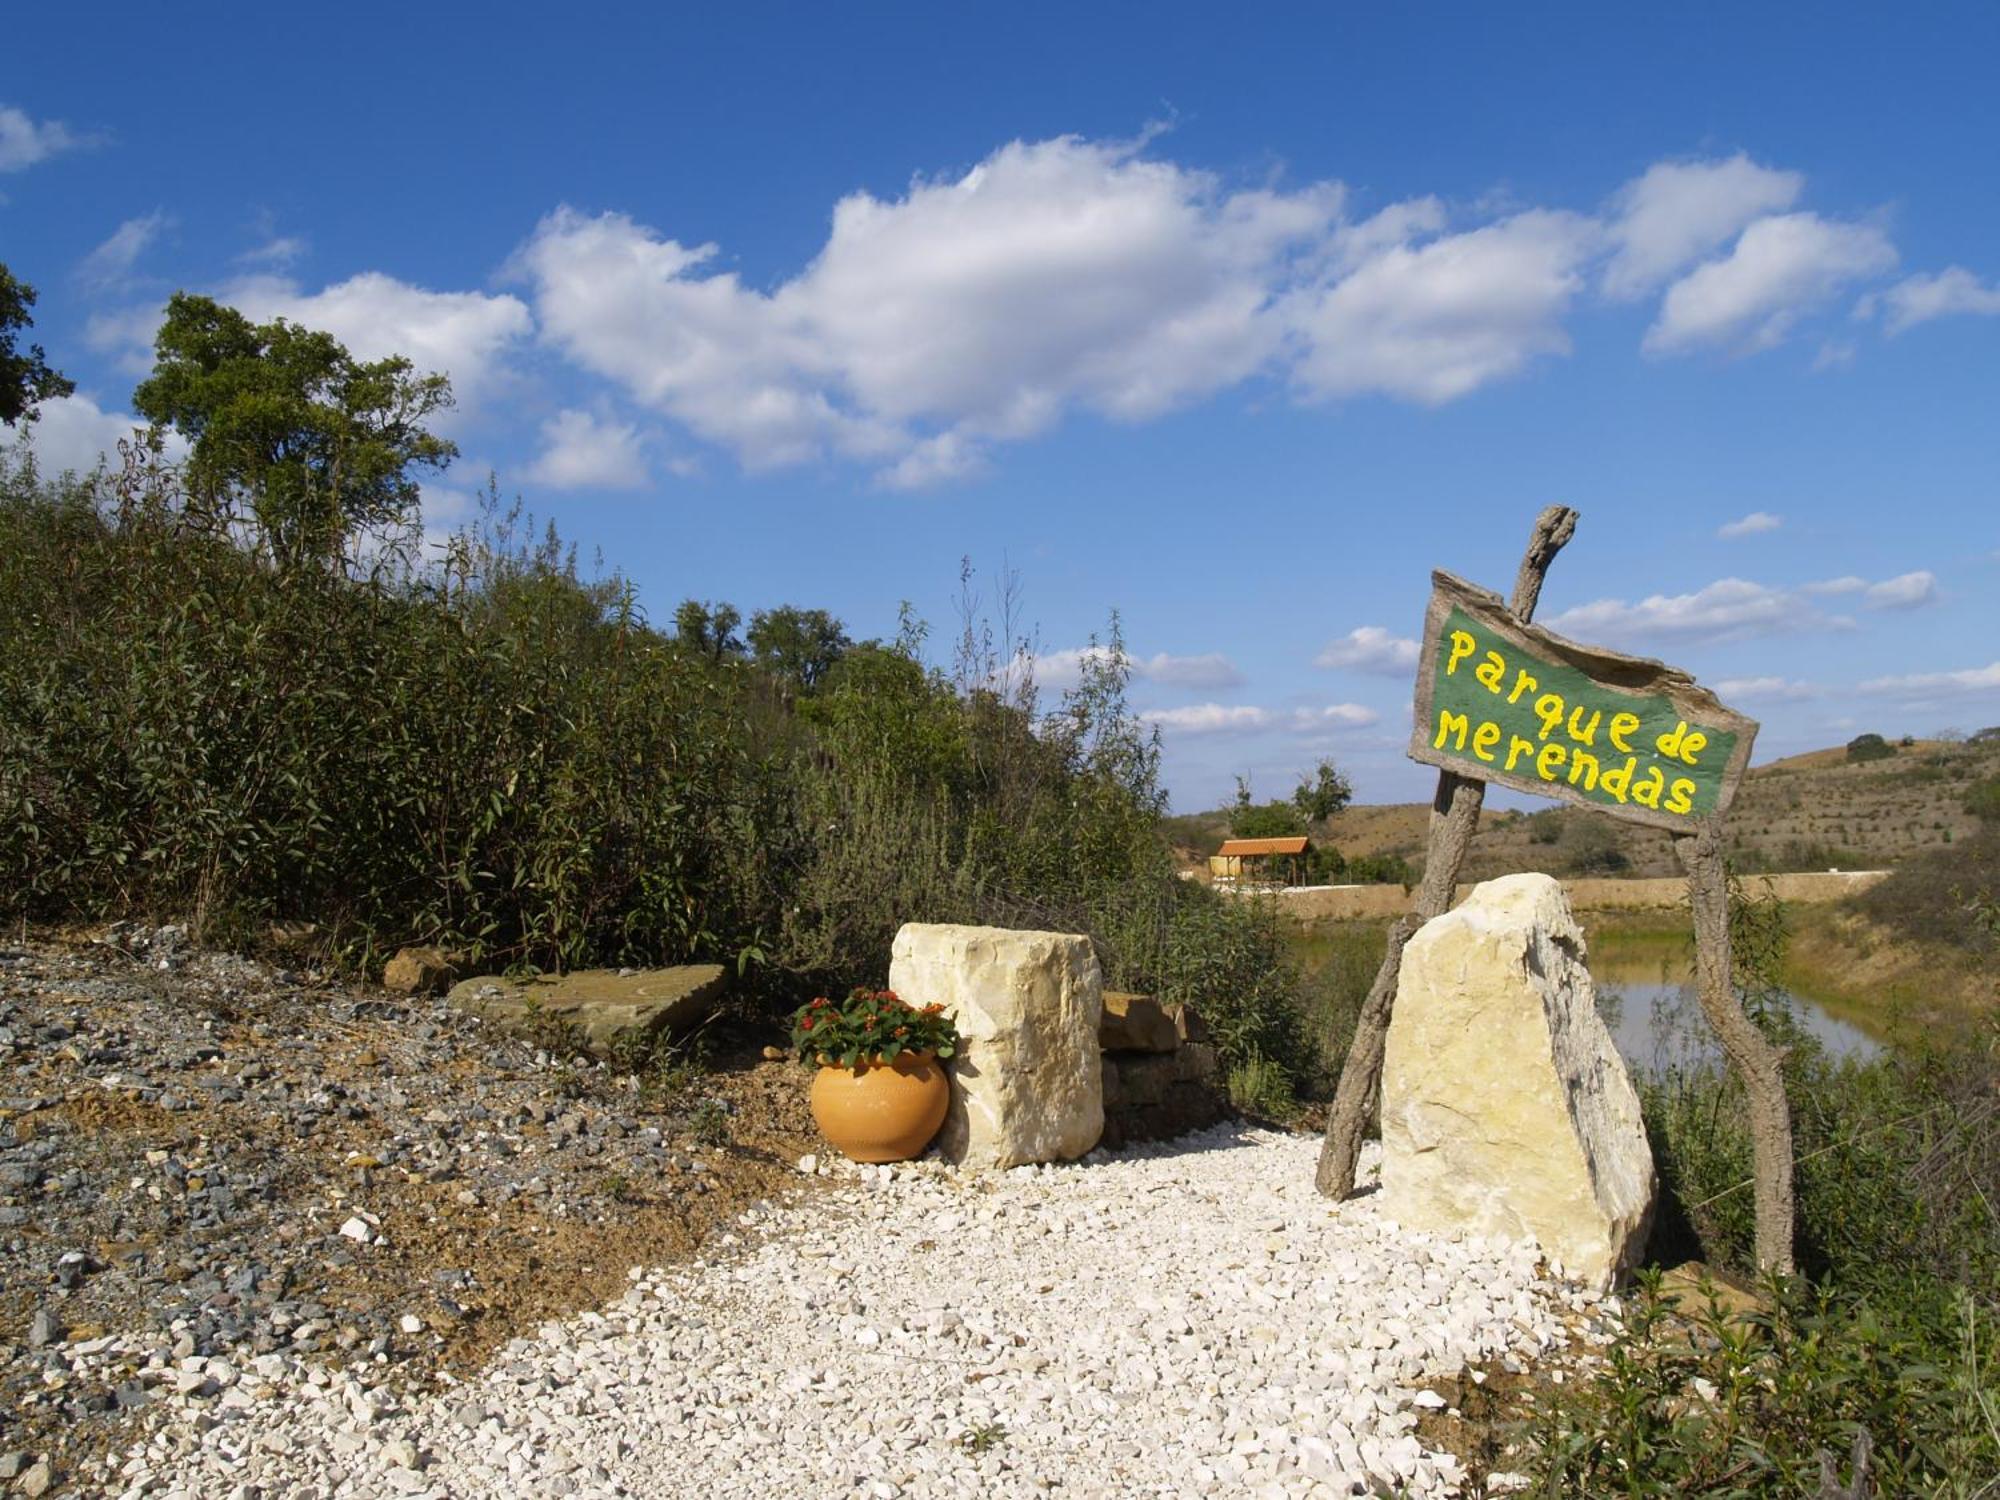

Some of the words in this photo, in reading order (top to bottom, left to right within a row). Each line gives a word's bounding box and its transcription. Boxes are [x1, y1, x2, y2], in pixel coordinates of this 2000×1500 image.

[1446, 630, 1641, 753] Parque
[1655, 720, 1708, 765] de
[1433, 708, 1698, 815] Merendas
